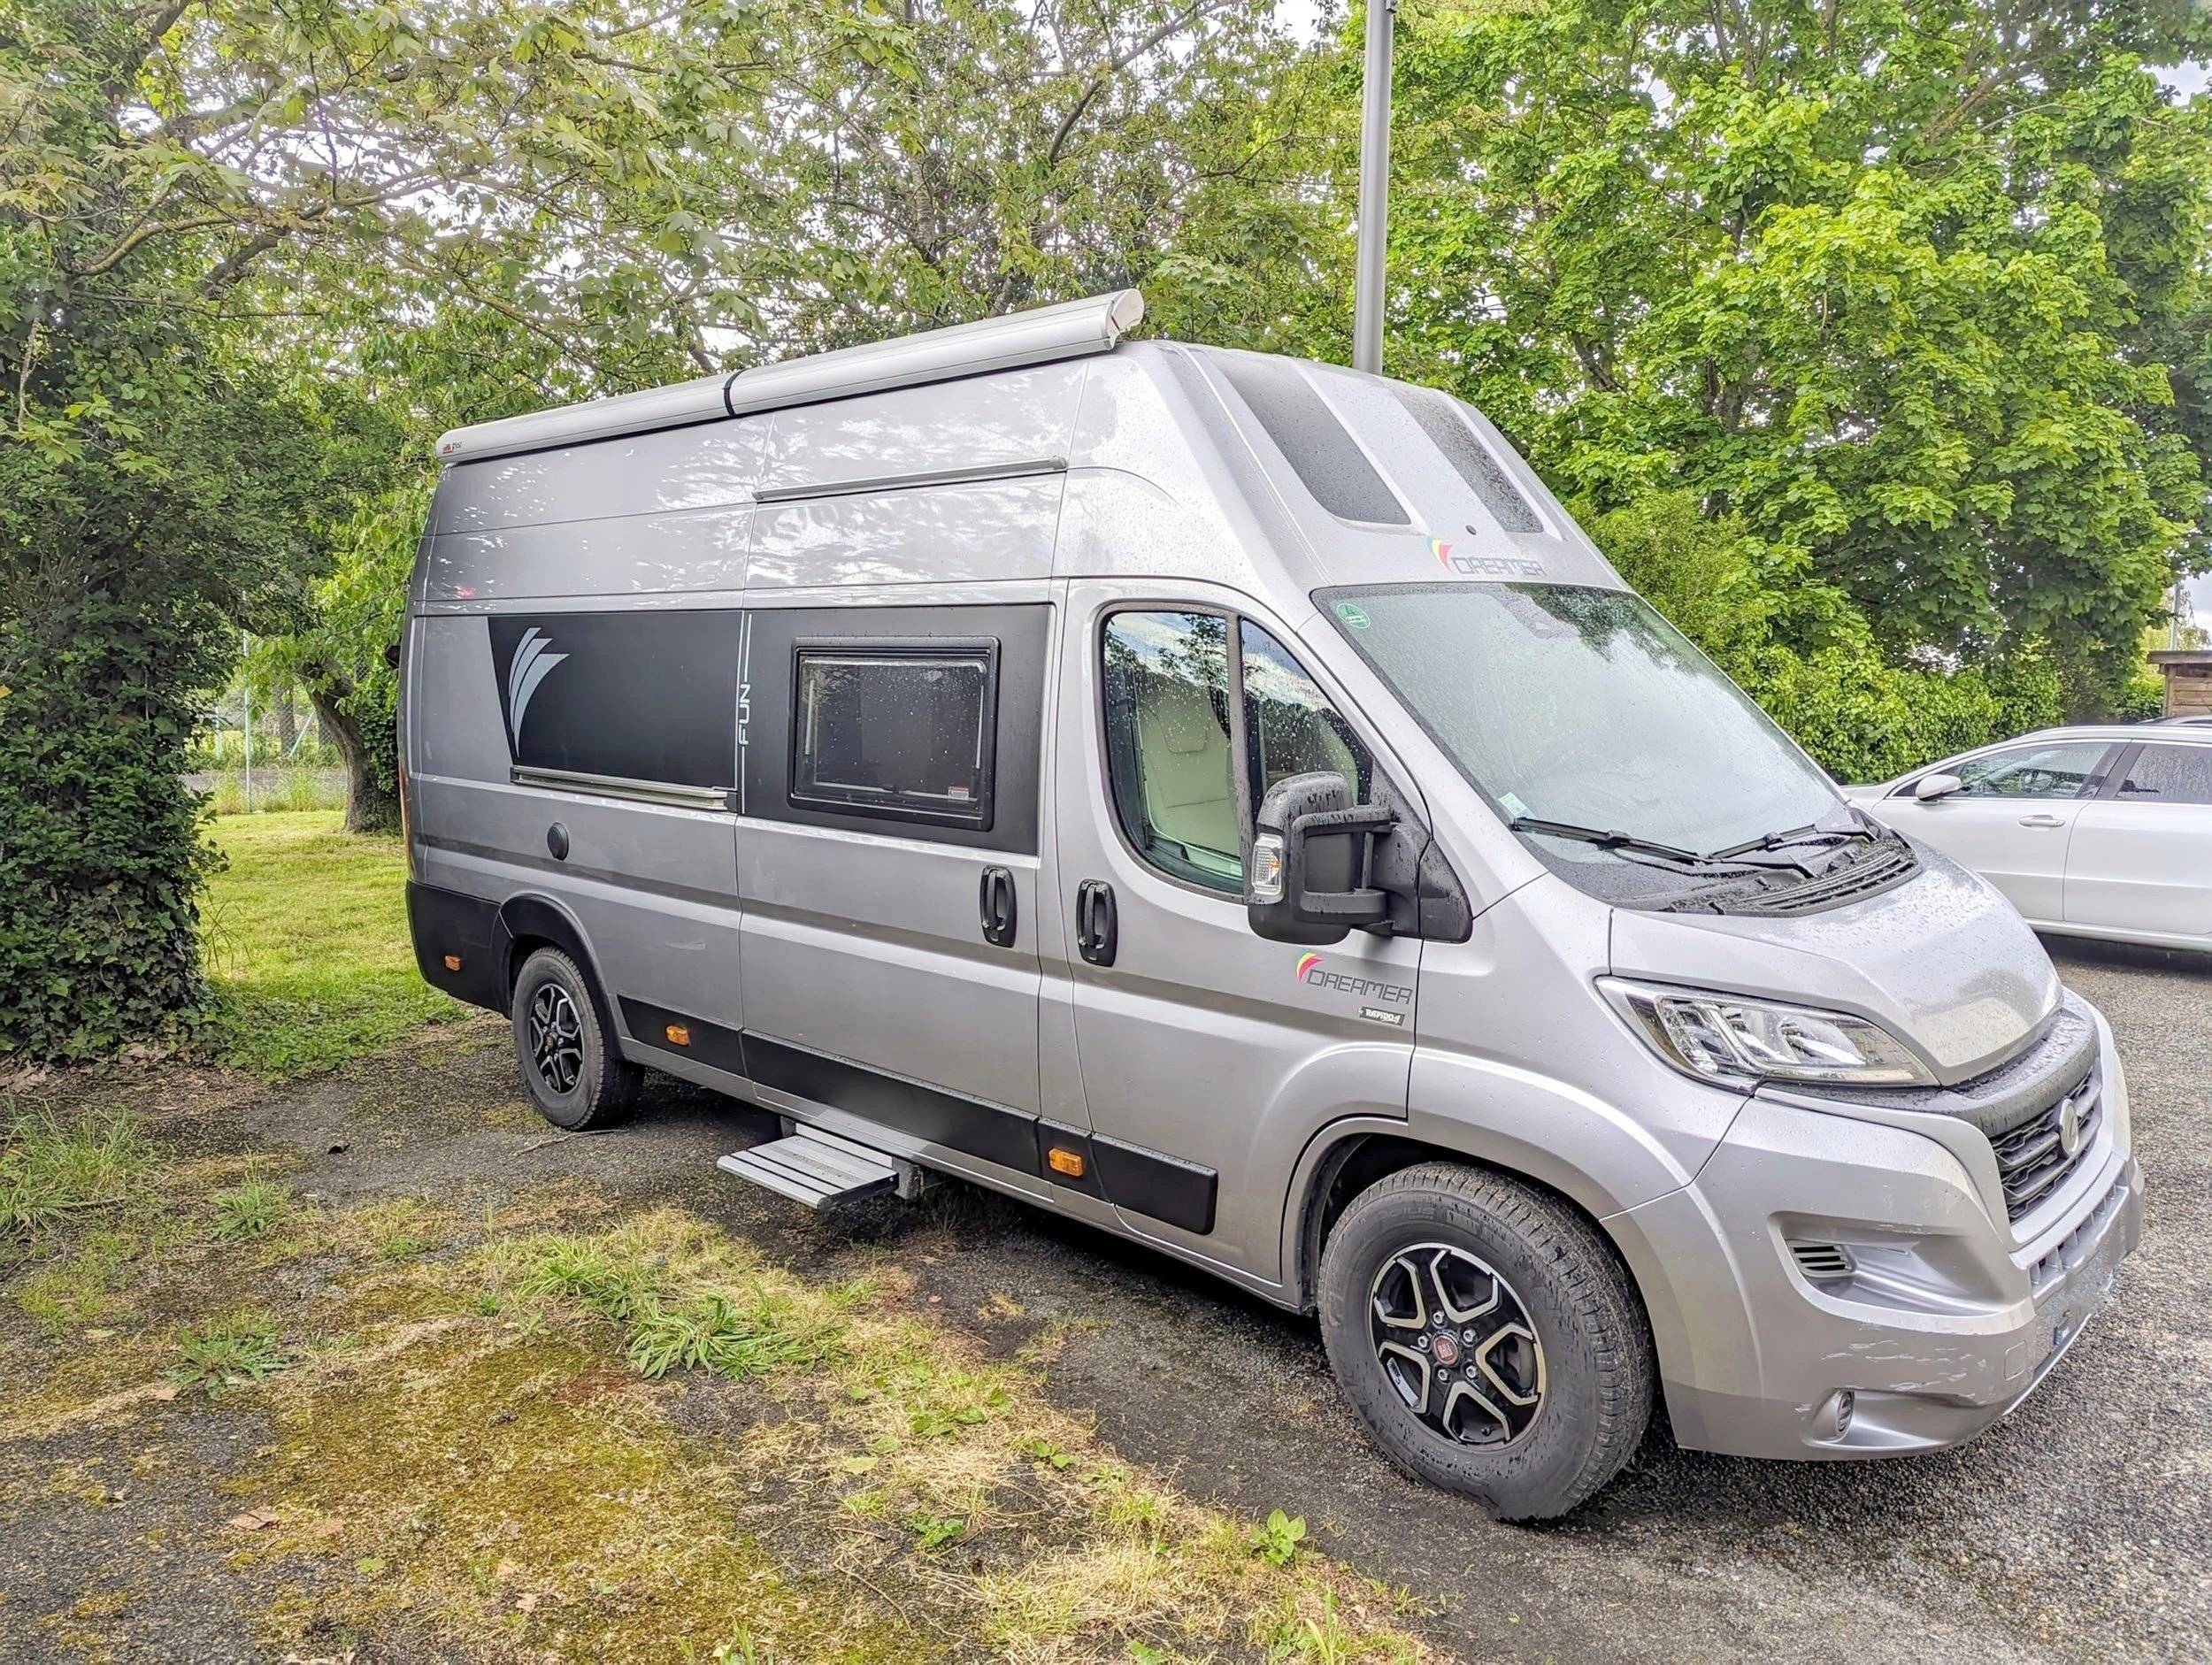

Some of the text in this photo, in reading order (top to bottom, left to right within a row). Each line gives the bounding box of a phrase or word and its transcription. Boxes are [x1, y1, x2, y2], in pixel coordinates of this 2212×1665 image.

[1452, 557, 1547, 575] DREAMER
[739, 684, 750, 744] FUN
[1307, 969, 1413, 1004] DREAMER
